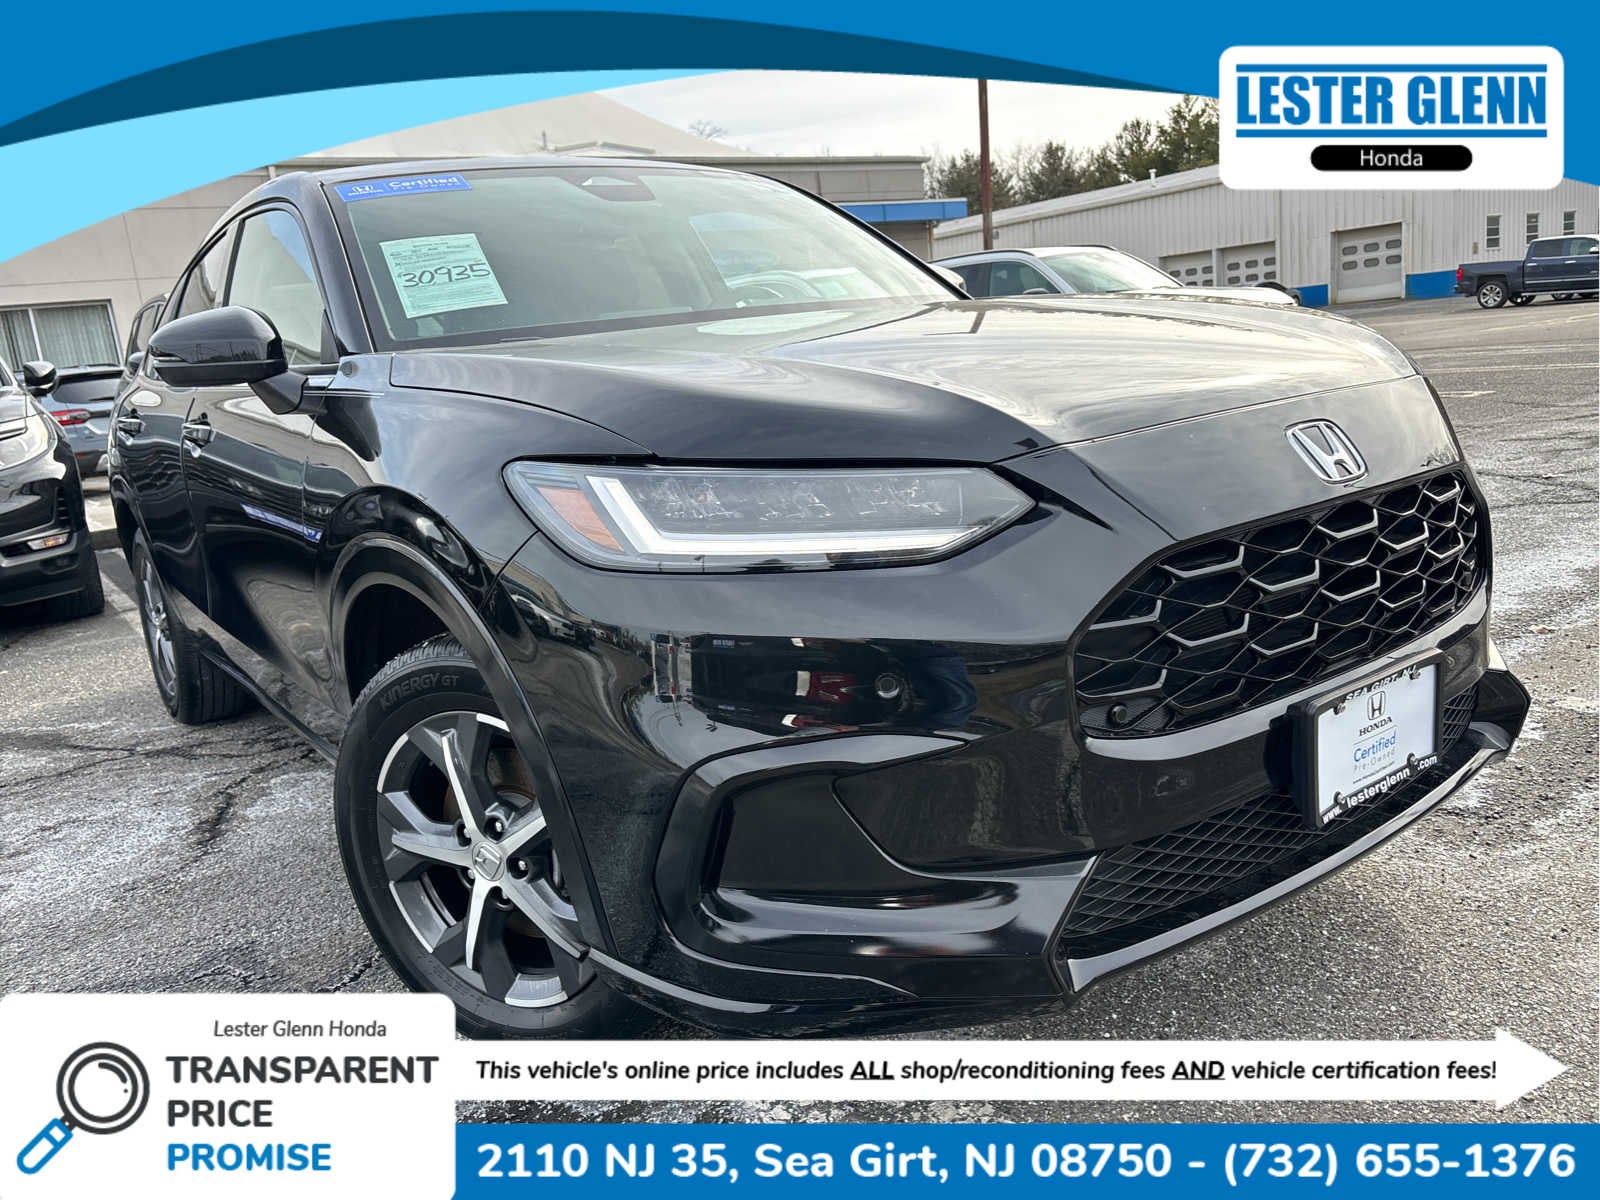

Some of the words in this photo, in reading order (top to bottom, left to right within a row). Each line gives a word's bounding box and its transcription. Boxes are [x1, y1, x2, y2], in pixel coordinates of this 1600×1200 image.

[388, 176, 458, 187] Certified
[380, 672, 441, 711] KINERGY
[441, 675, 460, 687] GT
[1359, 716, 1393, 737] HONDA
[1353, 730, 1396, 762] Certified
